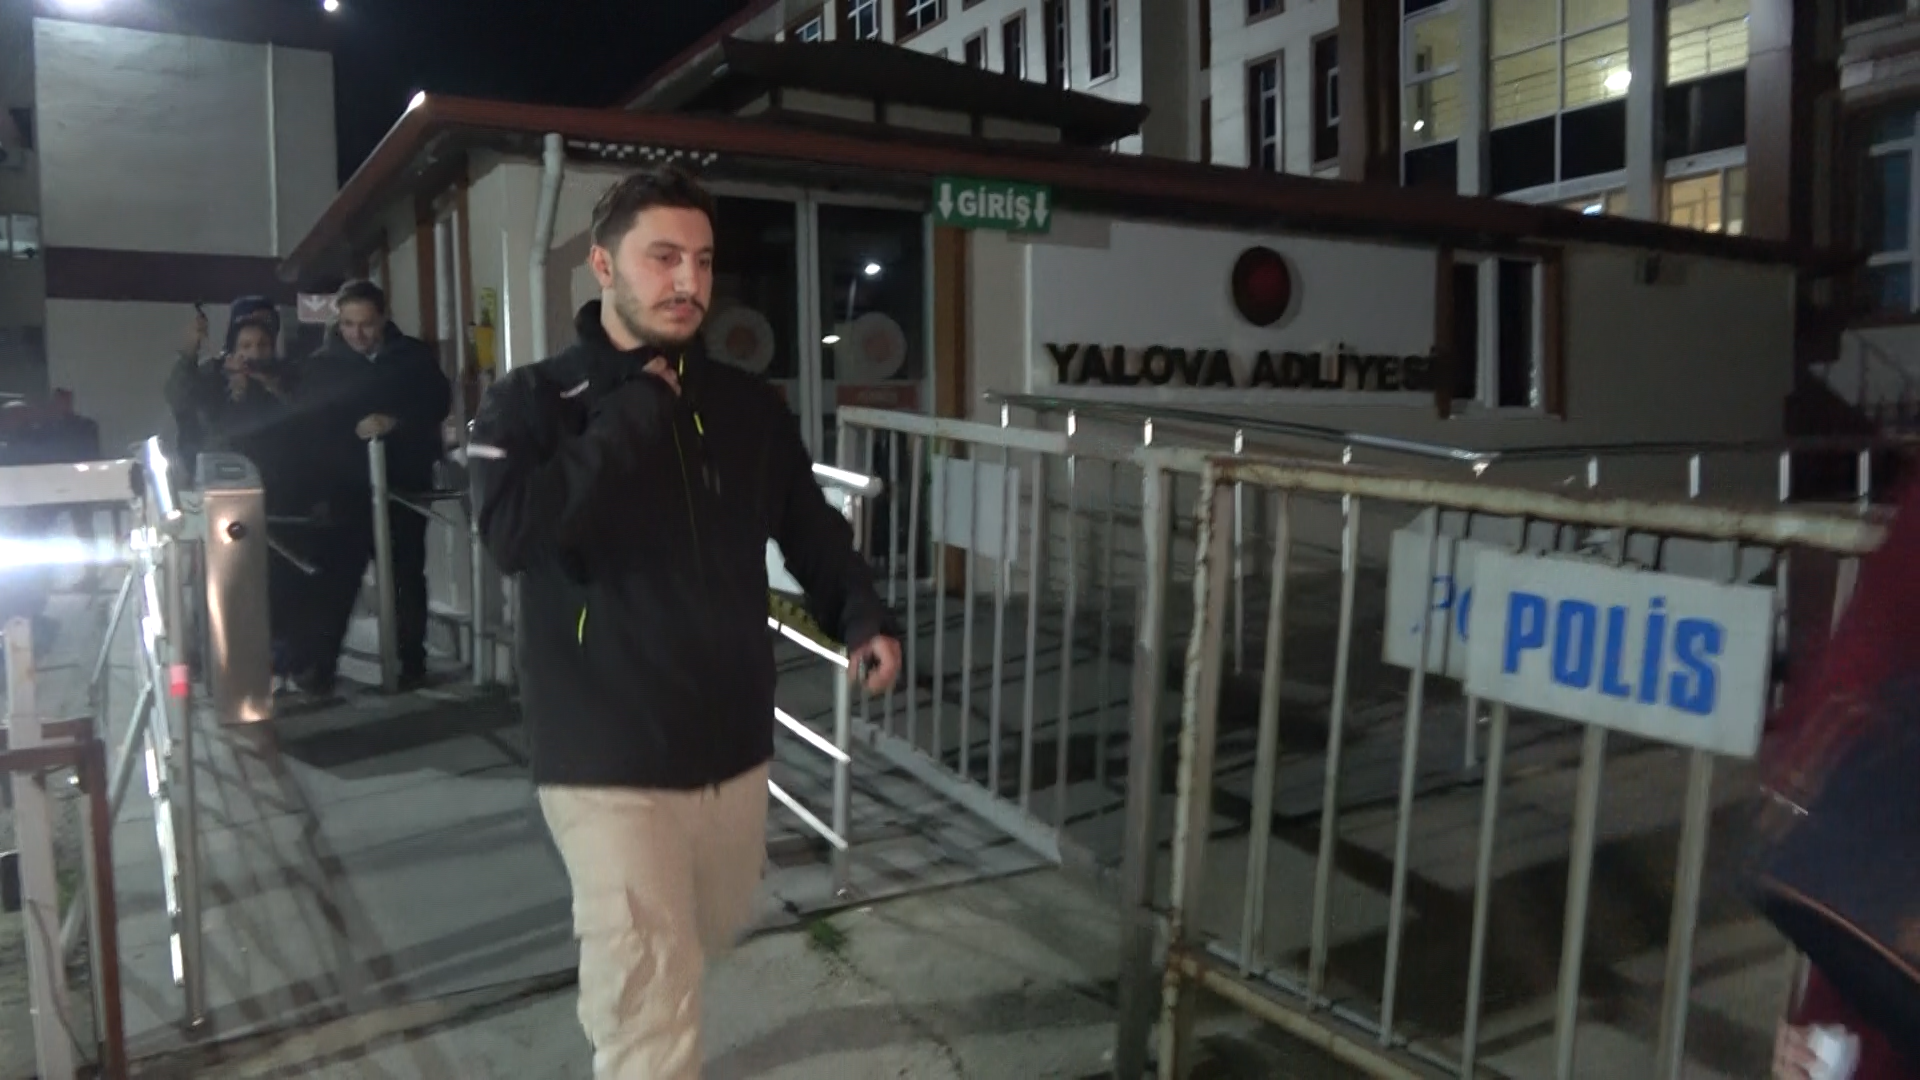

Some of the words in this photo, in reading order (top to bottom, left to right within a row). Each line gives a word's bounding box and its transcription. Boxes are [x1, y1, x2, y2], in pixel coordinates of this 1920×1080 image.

[957, 186, 1032, 227] GİRİŞ
[1047, 344, 1235, 388] YALOVA
[1504, 592, 1725, 715] POLİS
